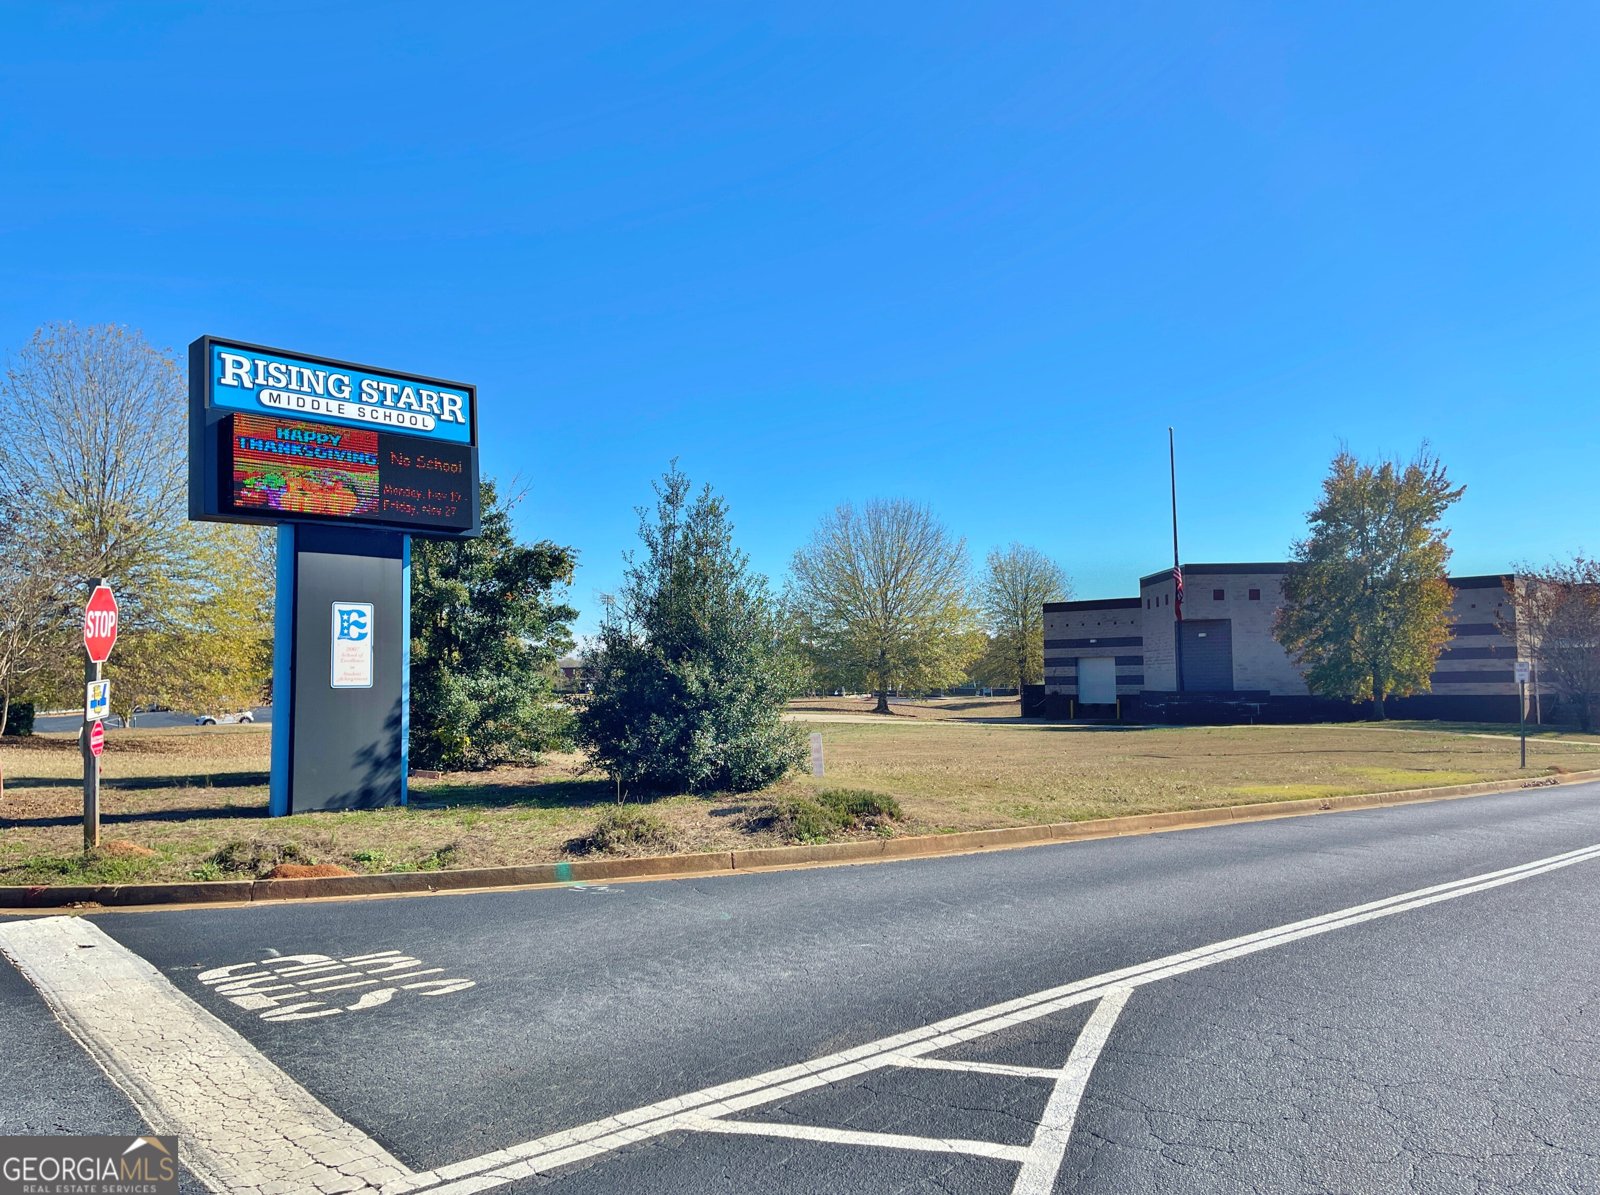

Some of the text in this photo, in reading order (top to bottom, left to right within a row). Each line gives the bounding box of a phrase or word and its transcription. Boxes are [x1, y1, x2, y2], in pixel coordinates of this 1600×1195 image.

[220, 352, 466, 424] RISING STARR
[269, 392, 430, 428] MIDDLE SCHOOL
[238, 436, 379, 465] THANKSGIVING
[276, 427, 342, 446] HAPPY
[390, 451, 462, 473] No School
[86, 610, 116, 639] STOP
[197, 950, 477, 1022] STOP
